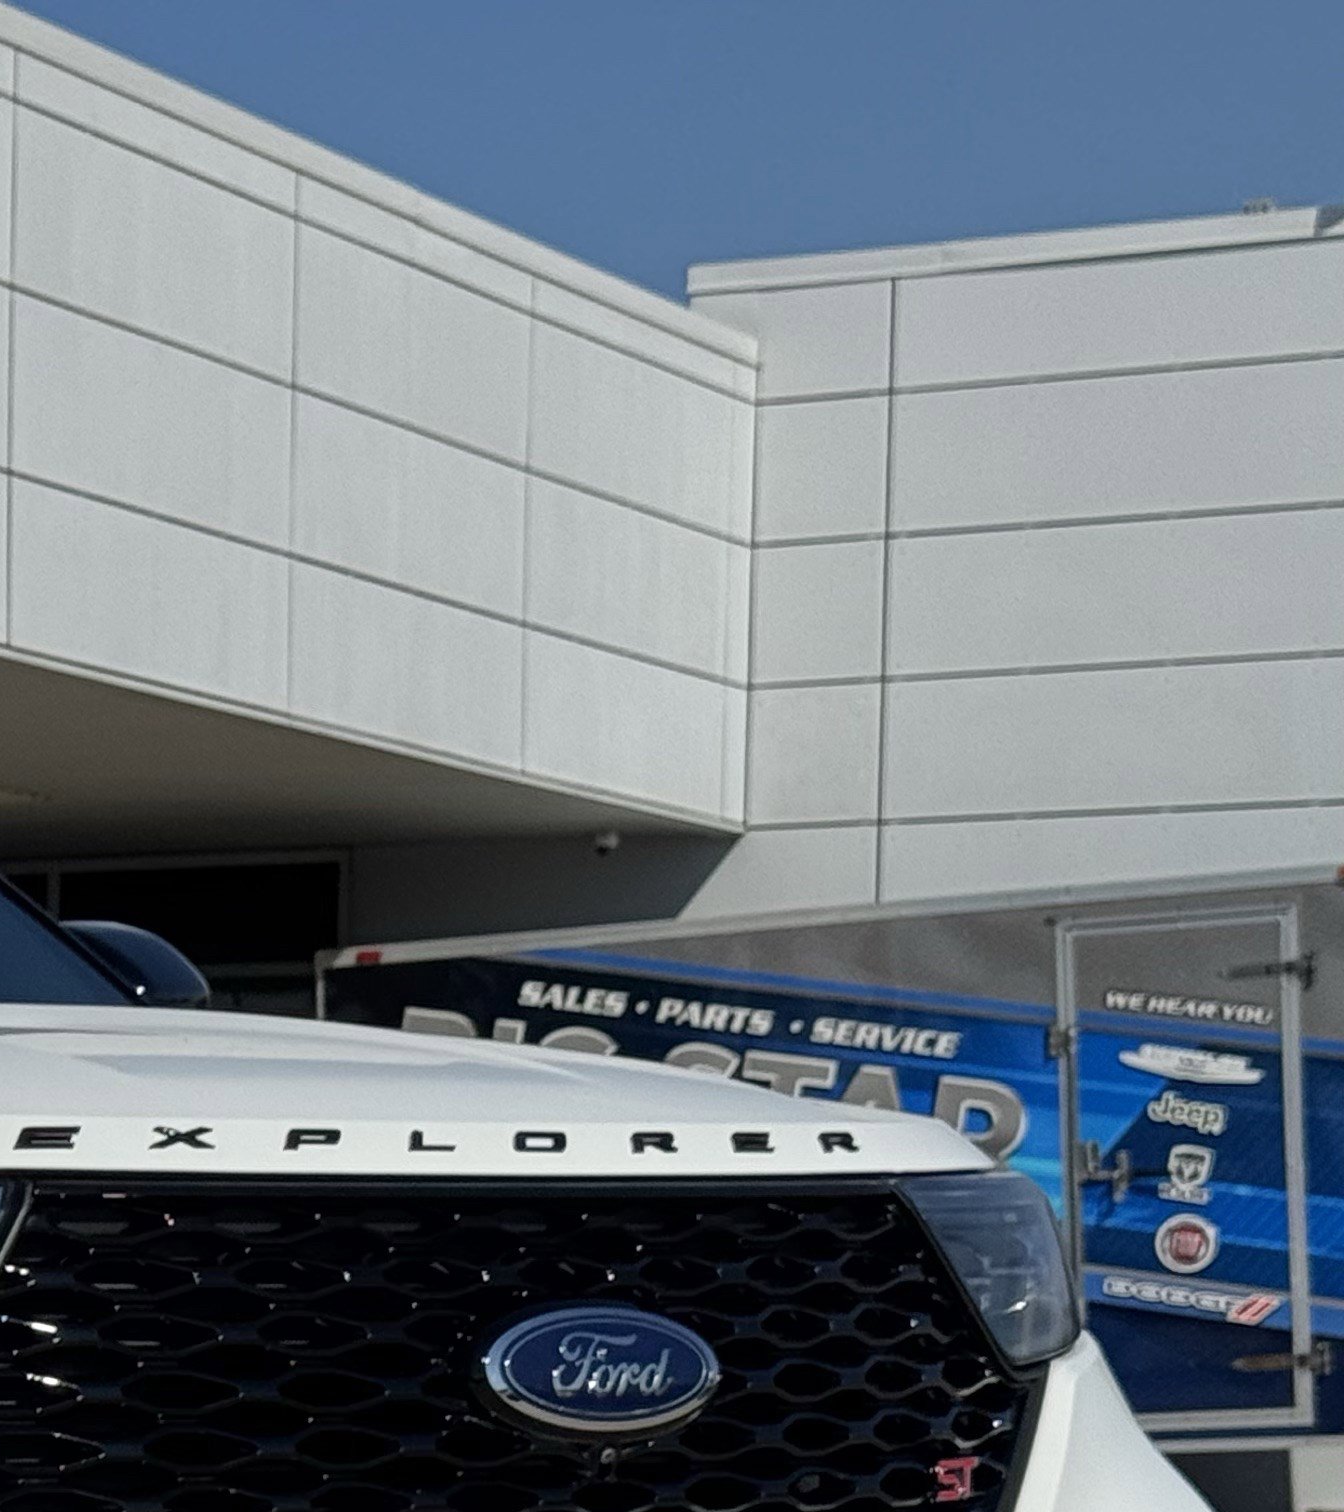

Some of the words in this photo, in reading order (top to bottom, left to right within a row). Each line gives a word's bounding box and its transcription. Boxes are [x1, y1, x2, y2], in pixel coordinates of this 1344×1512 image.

[518, 980, 627, 1017] SALES
[655, 998, 775, 1036] PARTS
[809, 1016, 963, 1060] SERVICE
[1106, 990, 1145, 1011] WE
[1147, 995, 1218, 1019] HEAR
[1221, 1004, 1274, 1025] YOU
[1149, 1093, 1224, 1133] Jeep
[12, 1124, 860, 1156] EXPLORER
[551, 1331, 673, 1397] Ford
[935, 1457, 980, 1500] ST
